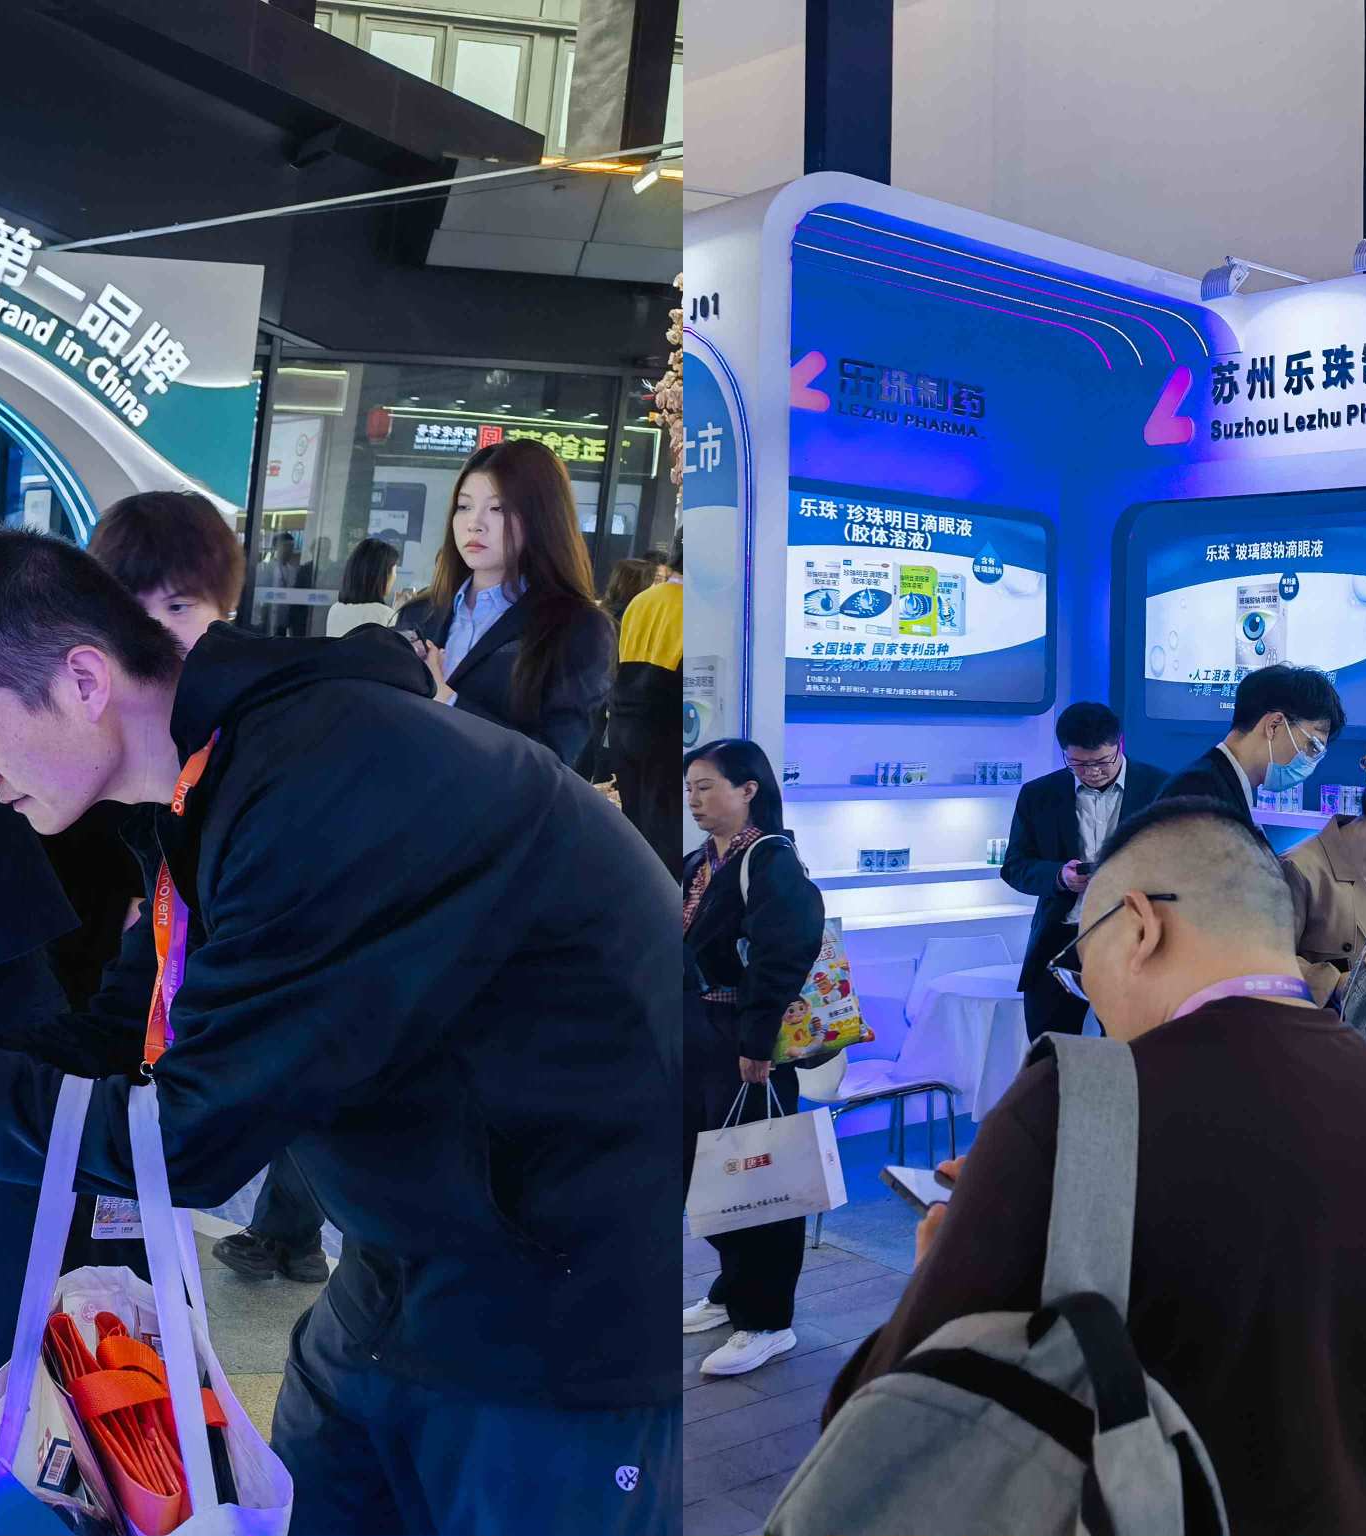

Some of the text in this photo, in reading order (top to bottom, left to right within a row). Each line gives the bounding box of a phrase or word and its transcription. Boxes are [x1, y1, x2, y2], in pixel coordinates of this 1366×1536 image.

[54, 329, 83, 362] in
[84, 353, 150, 428] China
[838, 357, 986, 421] 乐珠制药
[838, 400, 899, 423] LEZHU
[1210, 414, 1279, 441] Suzhou
[1283, 408, 1342, 436] Lezhu
[811, 642, 950, 657] 全国独家 国家专利品种
